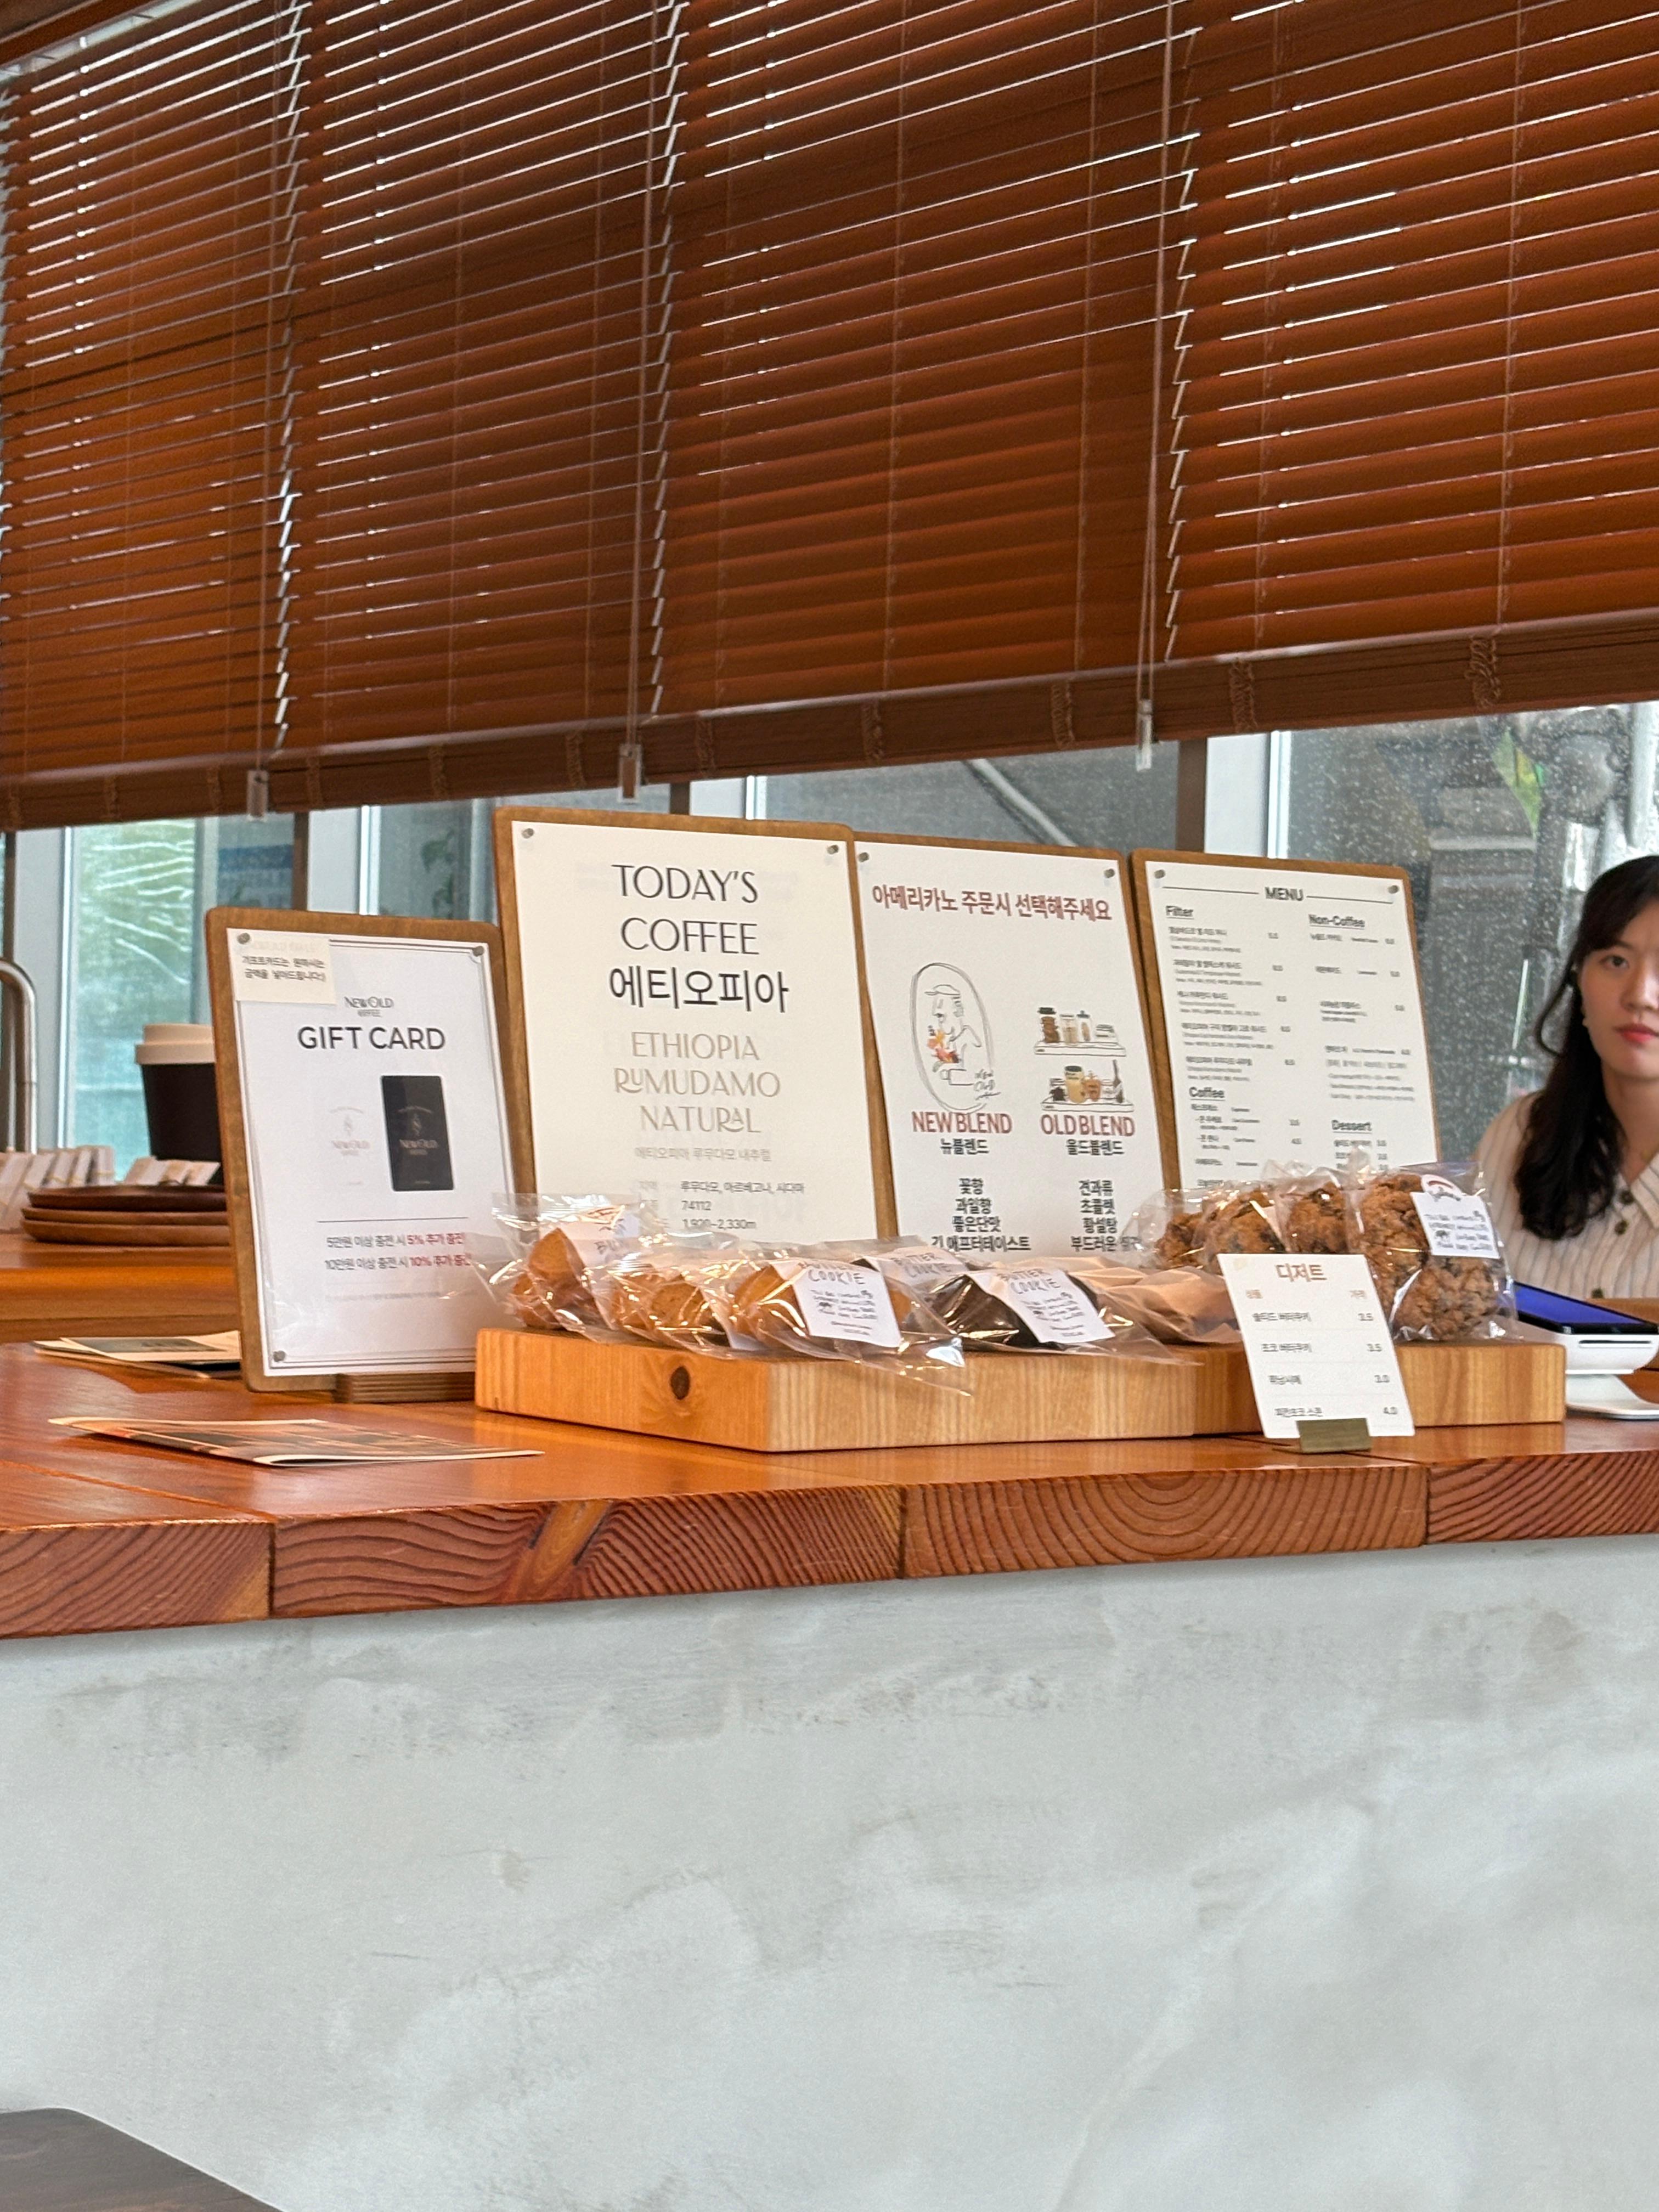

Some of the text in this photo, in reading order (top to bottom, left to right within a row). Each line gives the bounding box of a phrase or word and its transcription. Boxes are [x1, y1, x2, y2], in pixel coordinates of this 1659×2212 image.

[612, 864, 759, 904] TODAY'S
[1265, 887, 1304, 901] MENU
[872, 884, 1112, 922] 아메리카노 주문시 선택해주세요
[1166, 905, 1194, 917] Filter
[1308, 914, 1365, 928] Non-Coffee
[620, 917, 760, 955] COFFEE
[609, 964, 790, 1014] 에티오피아
[297, 1026, 446, 1050] GIFT CARD
[631, 1031, 760, 1061] ETHIOPIA
[613, 1067, 781, 1098] RUMUDAMO
[1189, 1087, 1225, 1098] Coffee
[640, 1105, 762, 1133] NATURAL
[1331, 1120, 1372, 1131] Dessert
[940, 1138, 989, 1155] 뉴블렌드
[1066, 1139, 1125, 1155] 올드블렌드
[1079, 1180, 1114, 1196] 견과류
[955, 1198, 991, 1215] 과일향
[1080, 1198, 1116, 1215] 초콜릿
[1071, 1236, 1116, 1252] 부드러운
[808, 1269, 865, 1285] COOKIE
[1275, 1263, 1327, 1282] 디저트
